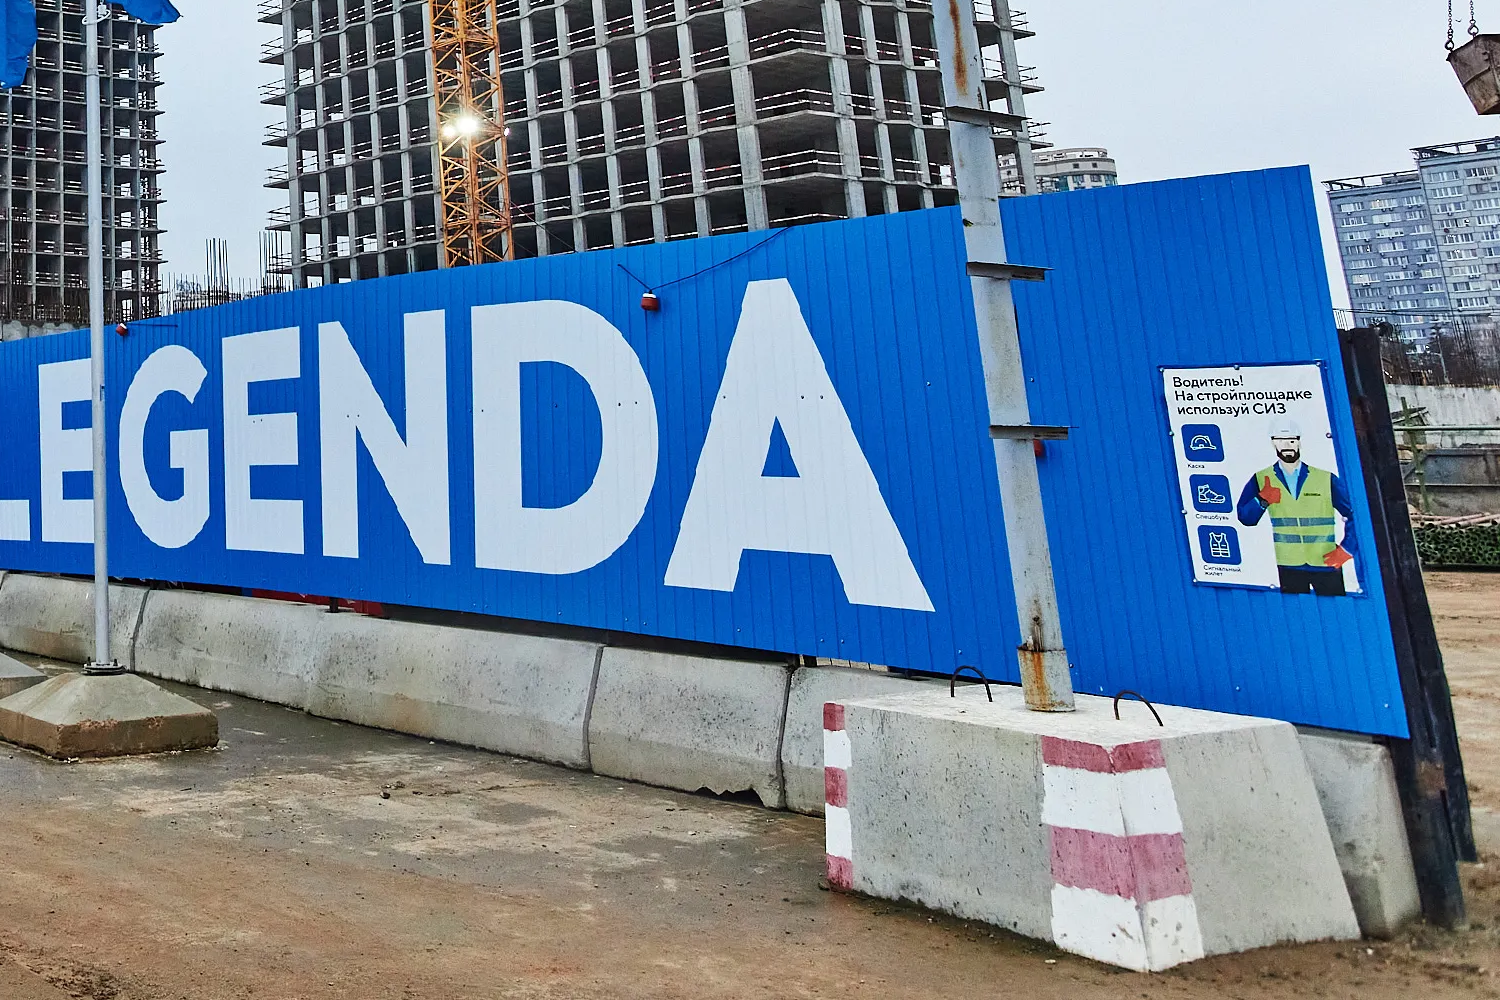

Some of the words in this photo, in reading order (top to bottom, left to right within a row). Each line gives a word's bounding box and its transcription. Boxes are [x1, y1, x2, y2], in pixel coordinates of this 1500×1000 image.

[1172, 375, 1244, 389] Водитель!
[1174, 390, 1194, 402] На
[1196, 388, 1313, 404] стройплощадке
[1177, 402, 1250, 418] используй
[1252, 402, 1287, 415] СИЗ
[1195, 513, 1230, 521] Спецобувь
[1203, 564, 1242, 573] Сигнальный
